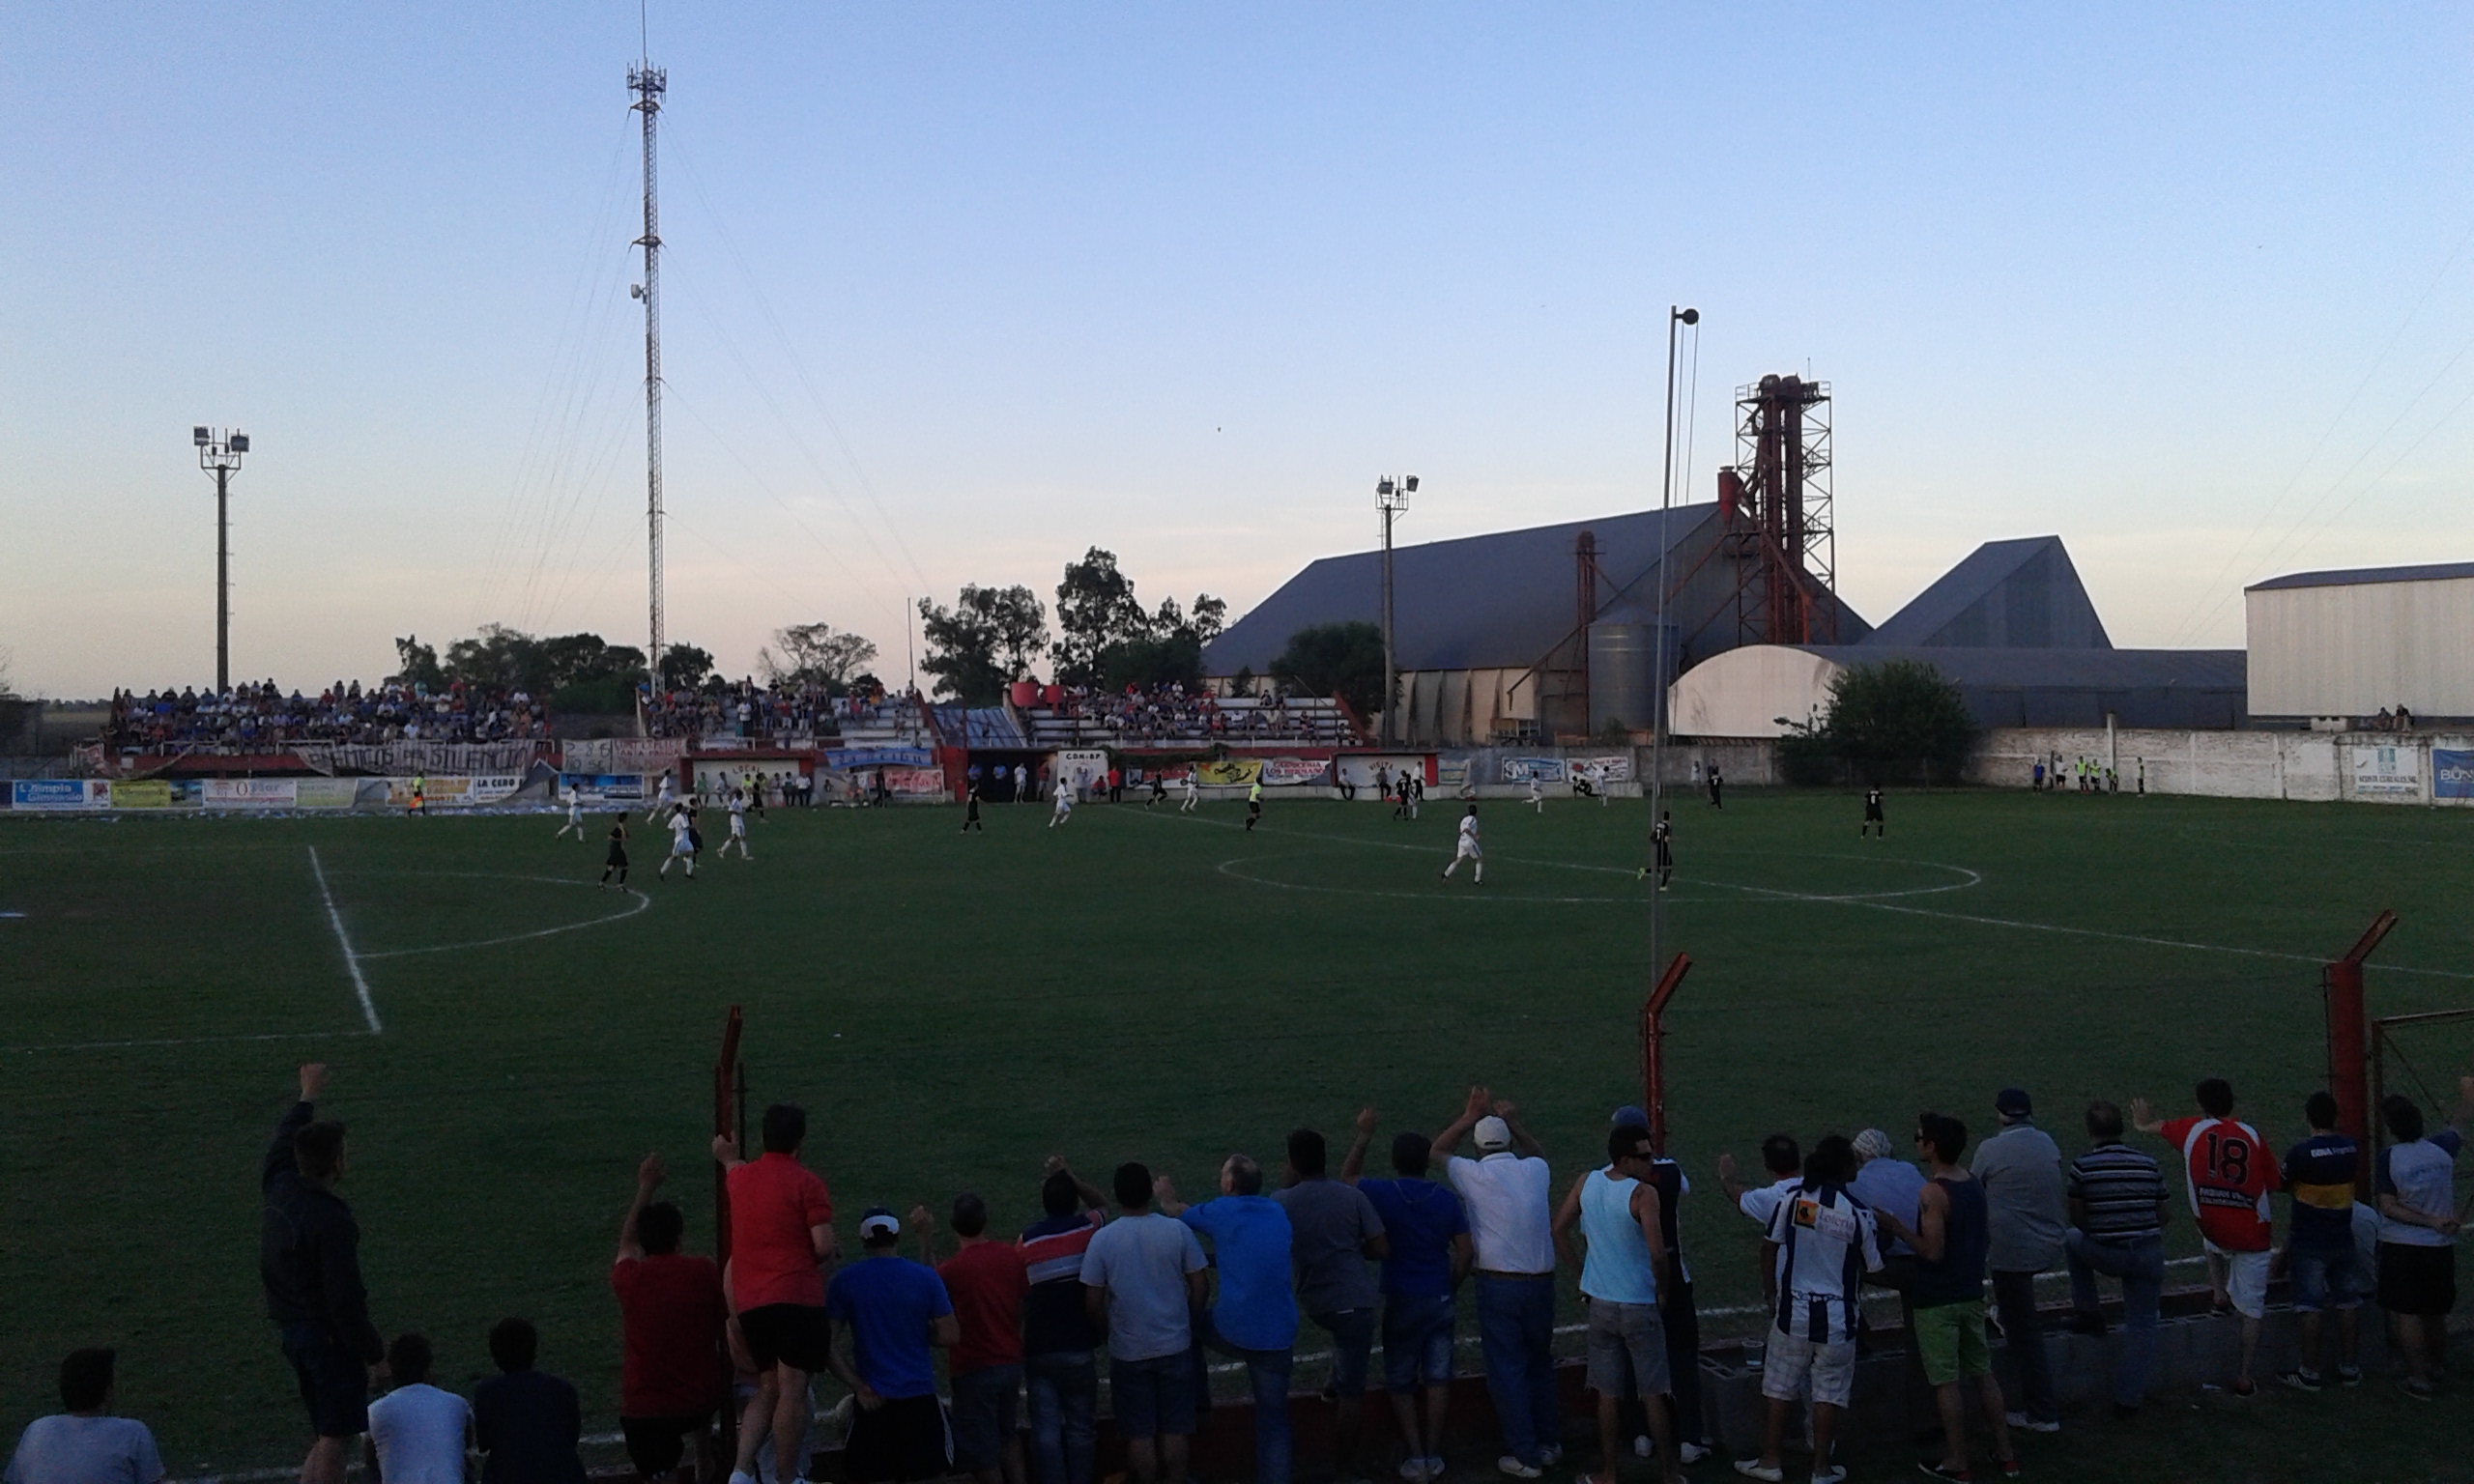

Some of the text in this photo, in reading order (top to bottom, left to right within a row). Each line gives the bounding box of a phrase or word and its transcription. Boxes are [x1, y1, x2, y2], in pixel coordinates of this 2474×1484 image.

[733, 764, 762, 775] LOCAL
[1368, 760, 1394, 771] VISITA
[2206, 1132, 2251, 1186] 18
